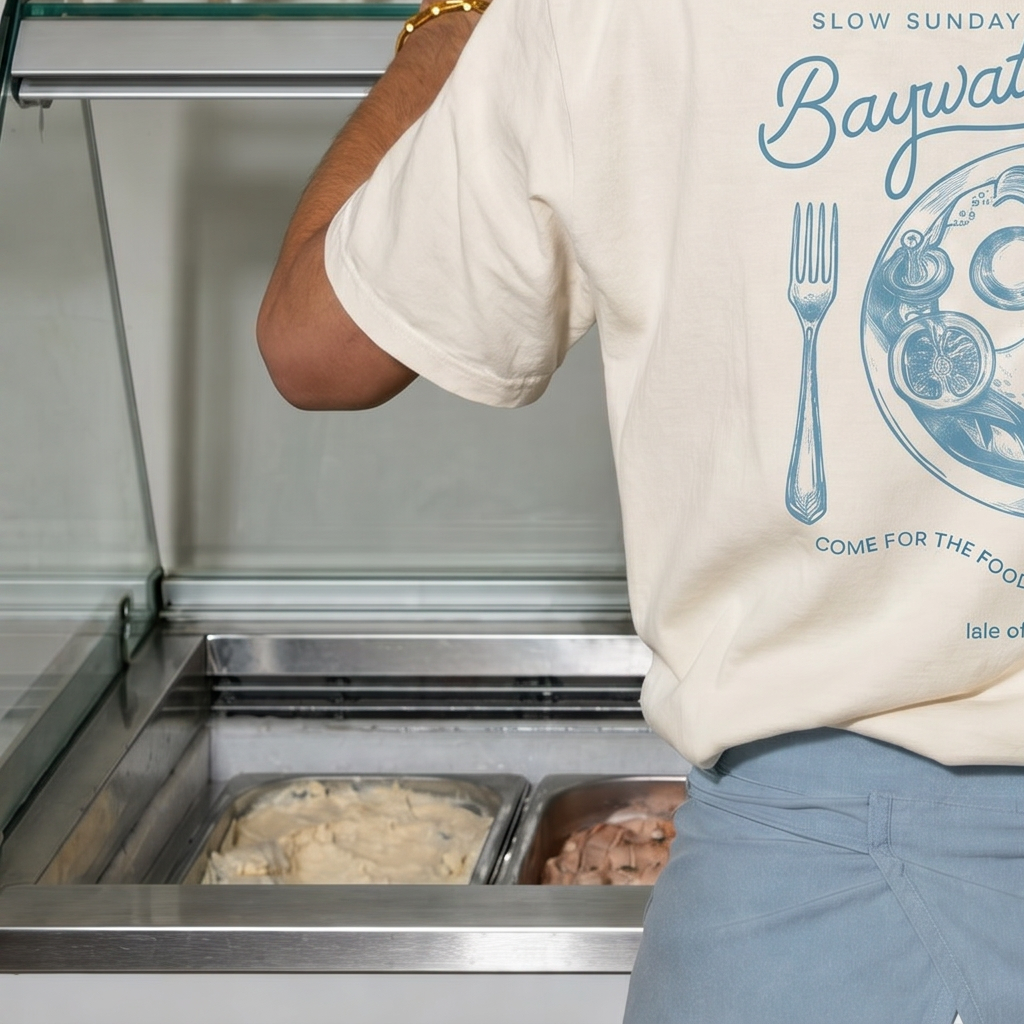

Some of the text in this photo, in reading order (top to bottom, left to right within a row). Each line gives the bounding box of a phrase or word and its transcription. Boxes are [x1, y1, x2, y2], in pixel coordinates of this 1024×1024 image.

[811, 11, 1021, 31] SLOW SUNDAY
[815, 535, 879, 556] COME
[883, 530, 928, 549] FOR
[934, 531, 976, 559] THE
